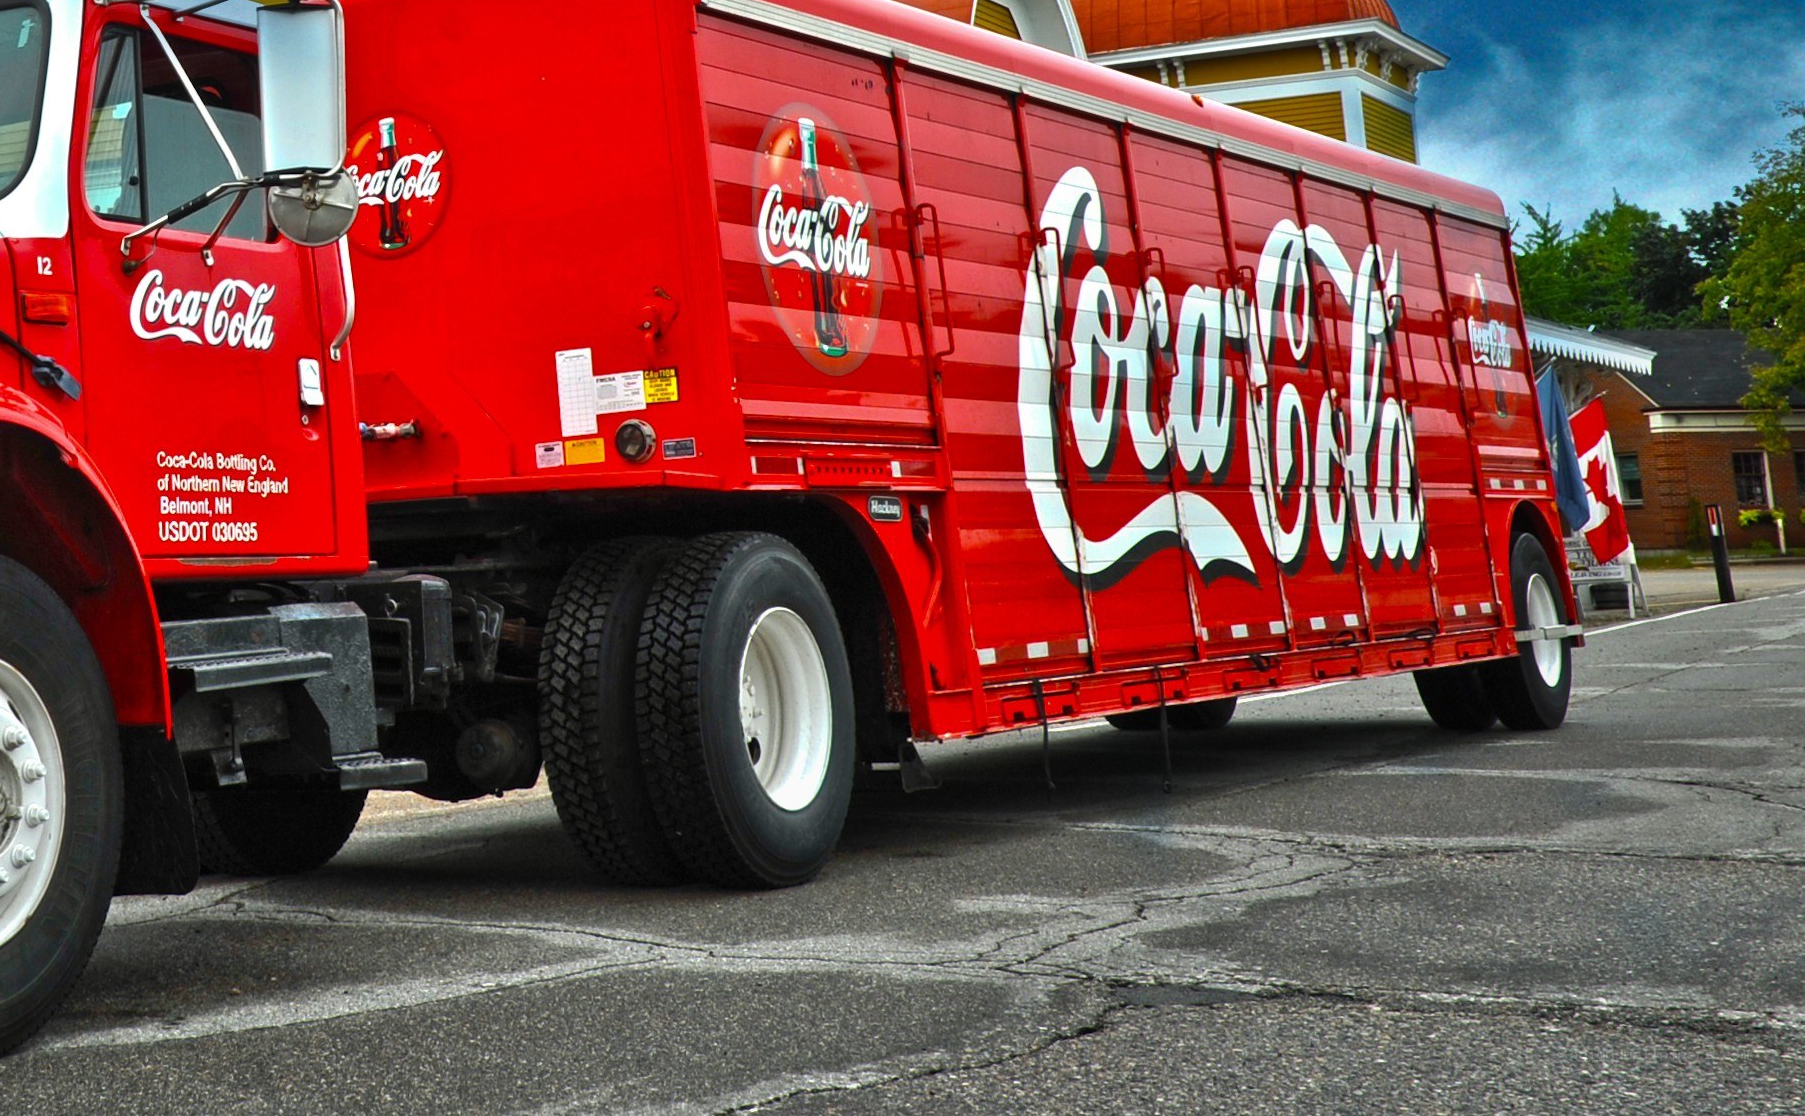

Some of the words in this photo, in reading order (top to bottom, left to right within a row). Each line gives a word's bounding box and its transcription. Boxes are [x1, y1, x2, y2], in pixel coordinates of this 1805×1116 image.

[758, 184, 870, 277] Coca-Cola
[37, 256, 53, 276] 12
[130, 269, 276, 350] Coca-Cola
[1018, 166, 1425, 576] Coca-Cola
[156, 451, 214, 470] Coca-Cola
[216, 452, 257, 475] Bottling
[259, 454, 276, 472] Co.
[157, 474, 169, 491] of
[171, 474, 220, 492] Northern
[222, 475, 245, 493] New
[247, 476, 289, 498] England
[160, 496, 213, 517] Belmont,
[215, 497, 233, 515] NH
[158, 521, 209, 542] USDOT
[212, 521, 258, 542] 030695
